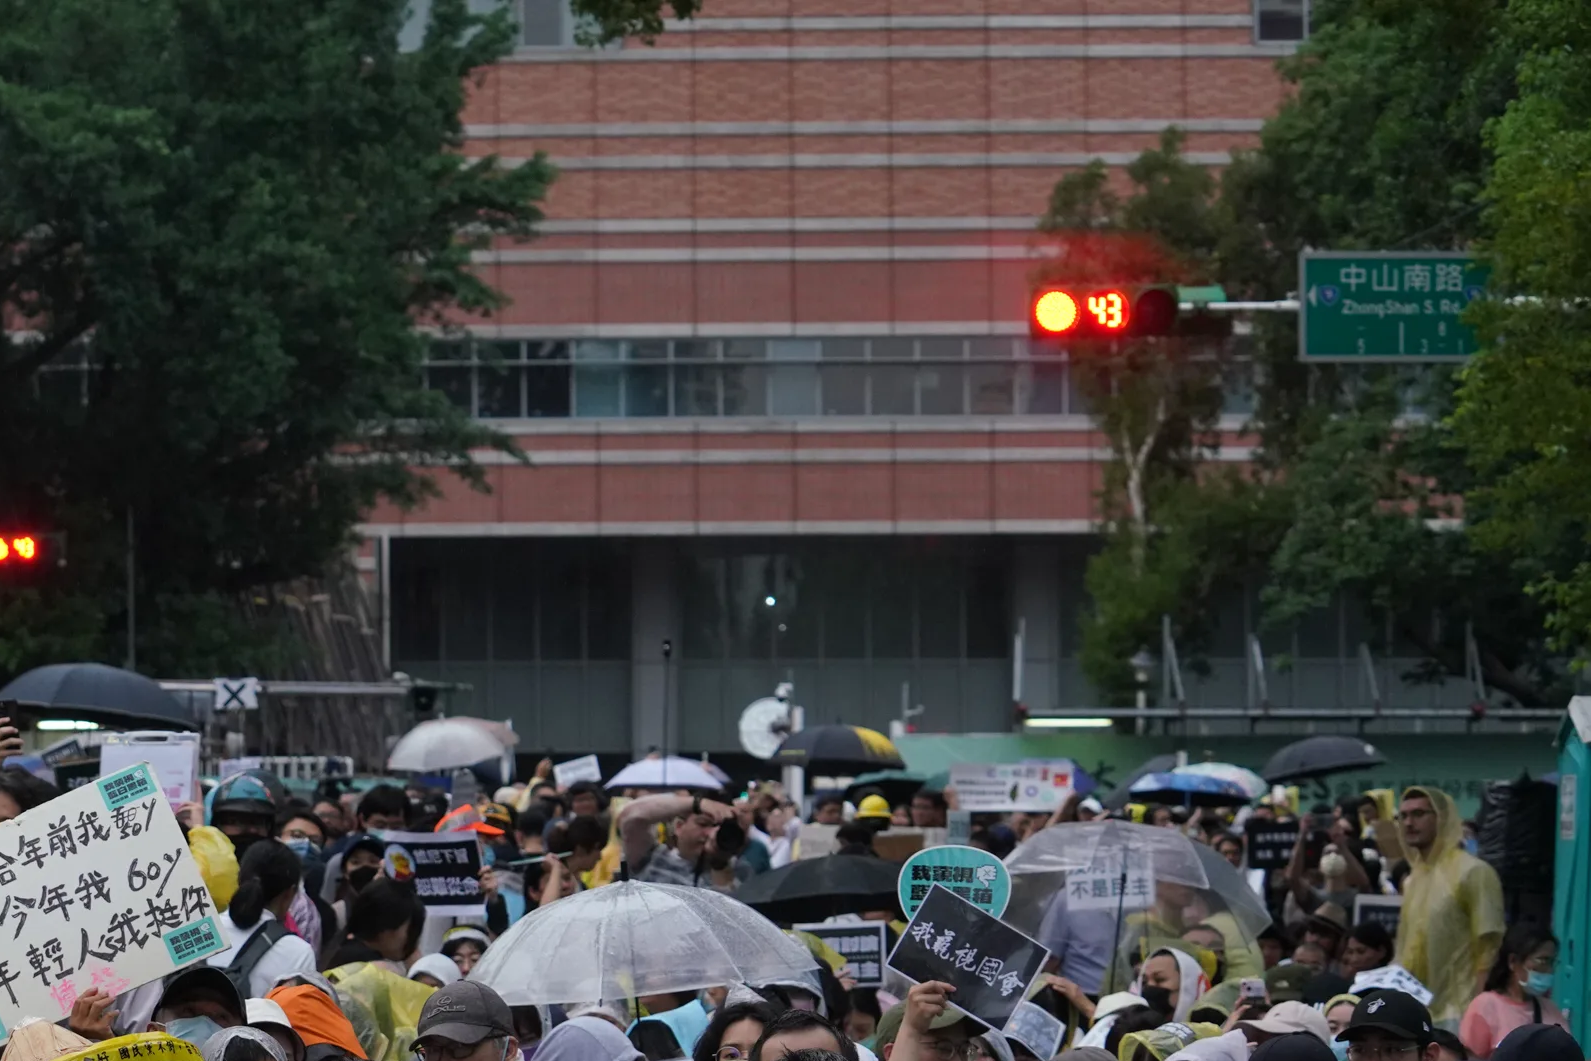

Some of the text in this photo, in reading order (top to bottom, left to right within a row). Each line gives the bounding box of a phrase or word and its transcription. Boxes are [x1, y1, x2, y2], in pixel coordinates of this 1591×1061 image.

[1339, 262, 1463, 292] 中山南路
[1088, 293, 1122, 328] 43
[1341, 300, 1420, 318] ZhongShan
[912, 921, 1026, 997] 我藐視國會
